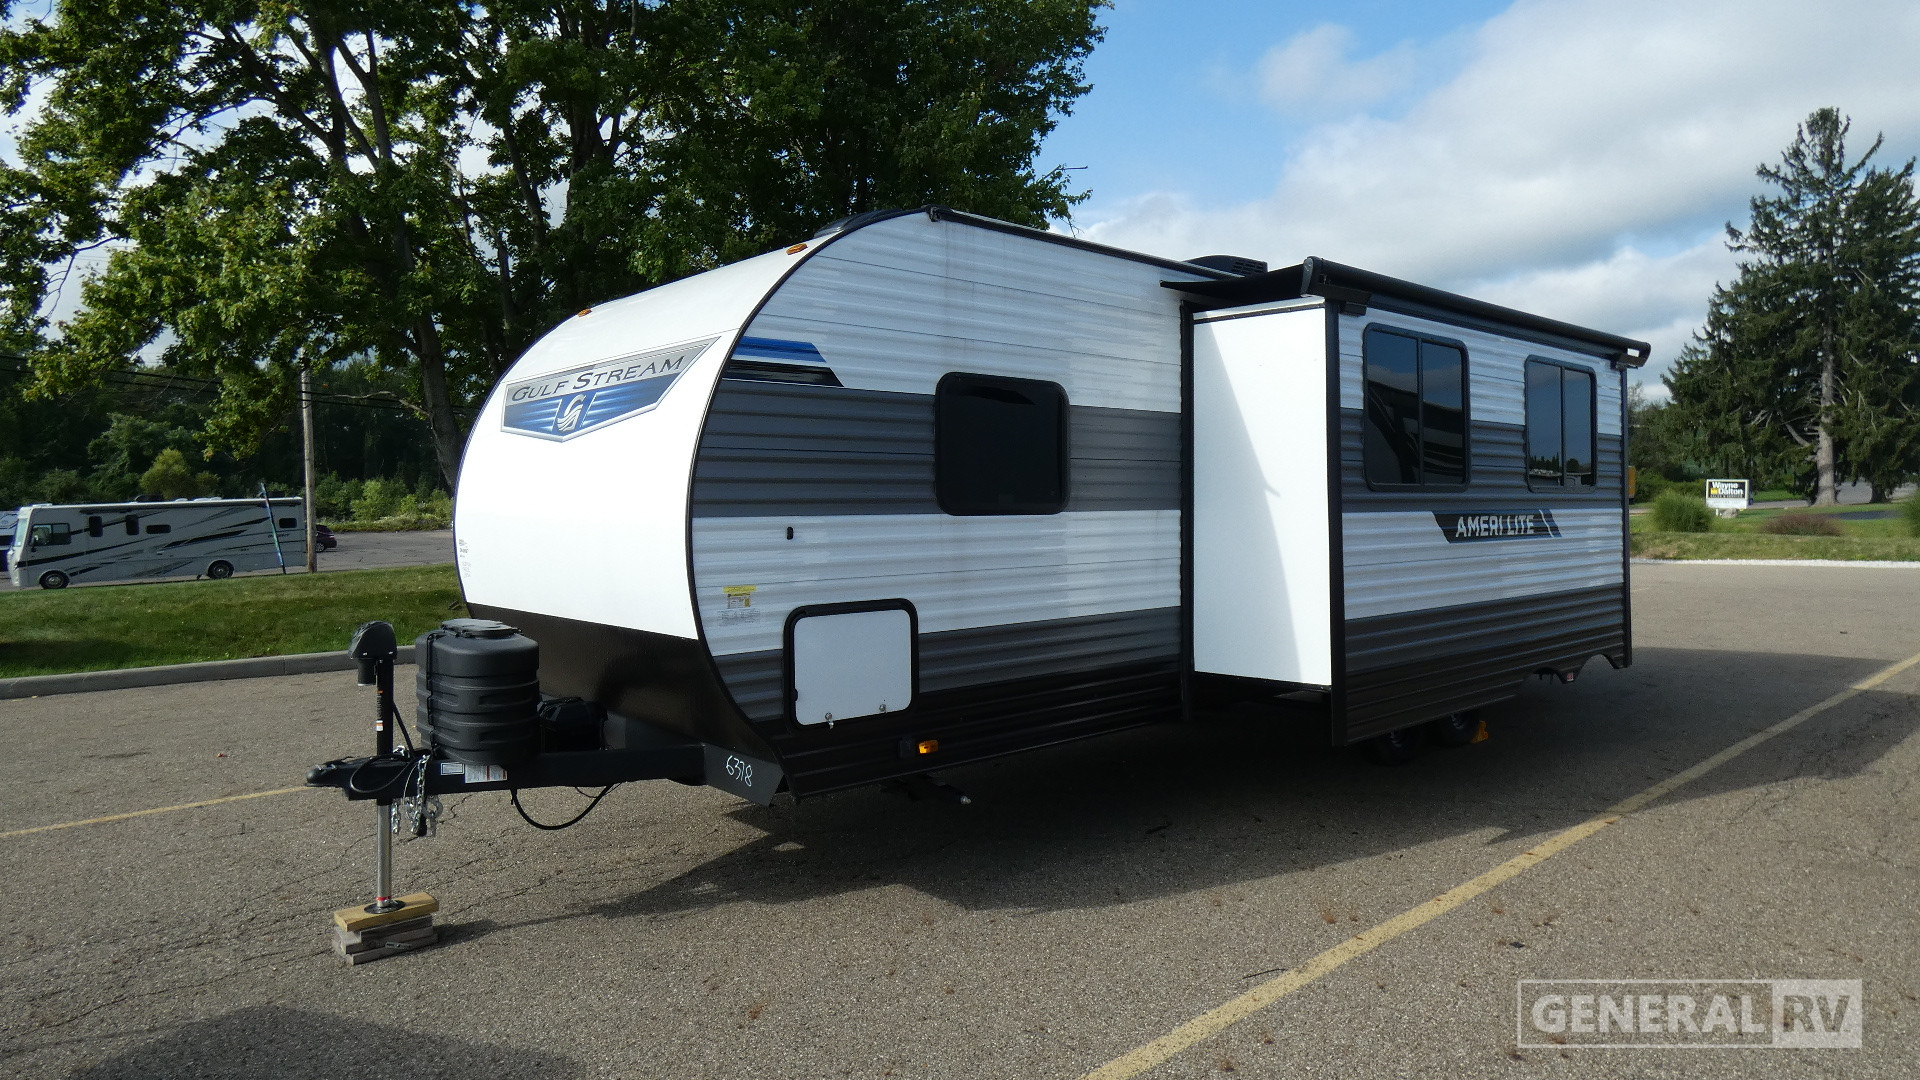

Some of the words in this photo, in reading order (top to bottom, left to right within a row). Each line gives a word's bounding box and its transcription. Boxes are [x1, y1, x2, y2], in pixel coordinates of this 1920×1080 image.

[512, 381, 569, 402] GULF
[573, 356, 684, 390] STREAM
[1711, 481, 1739, 490] Wayne
[725, 755, 752, 787] 6378
